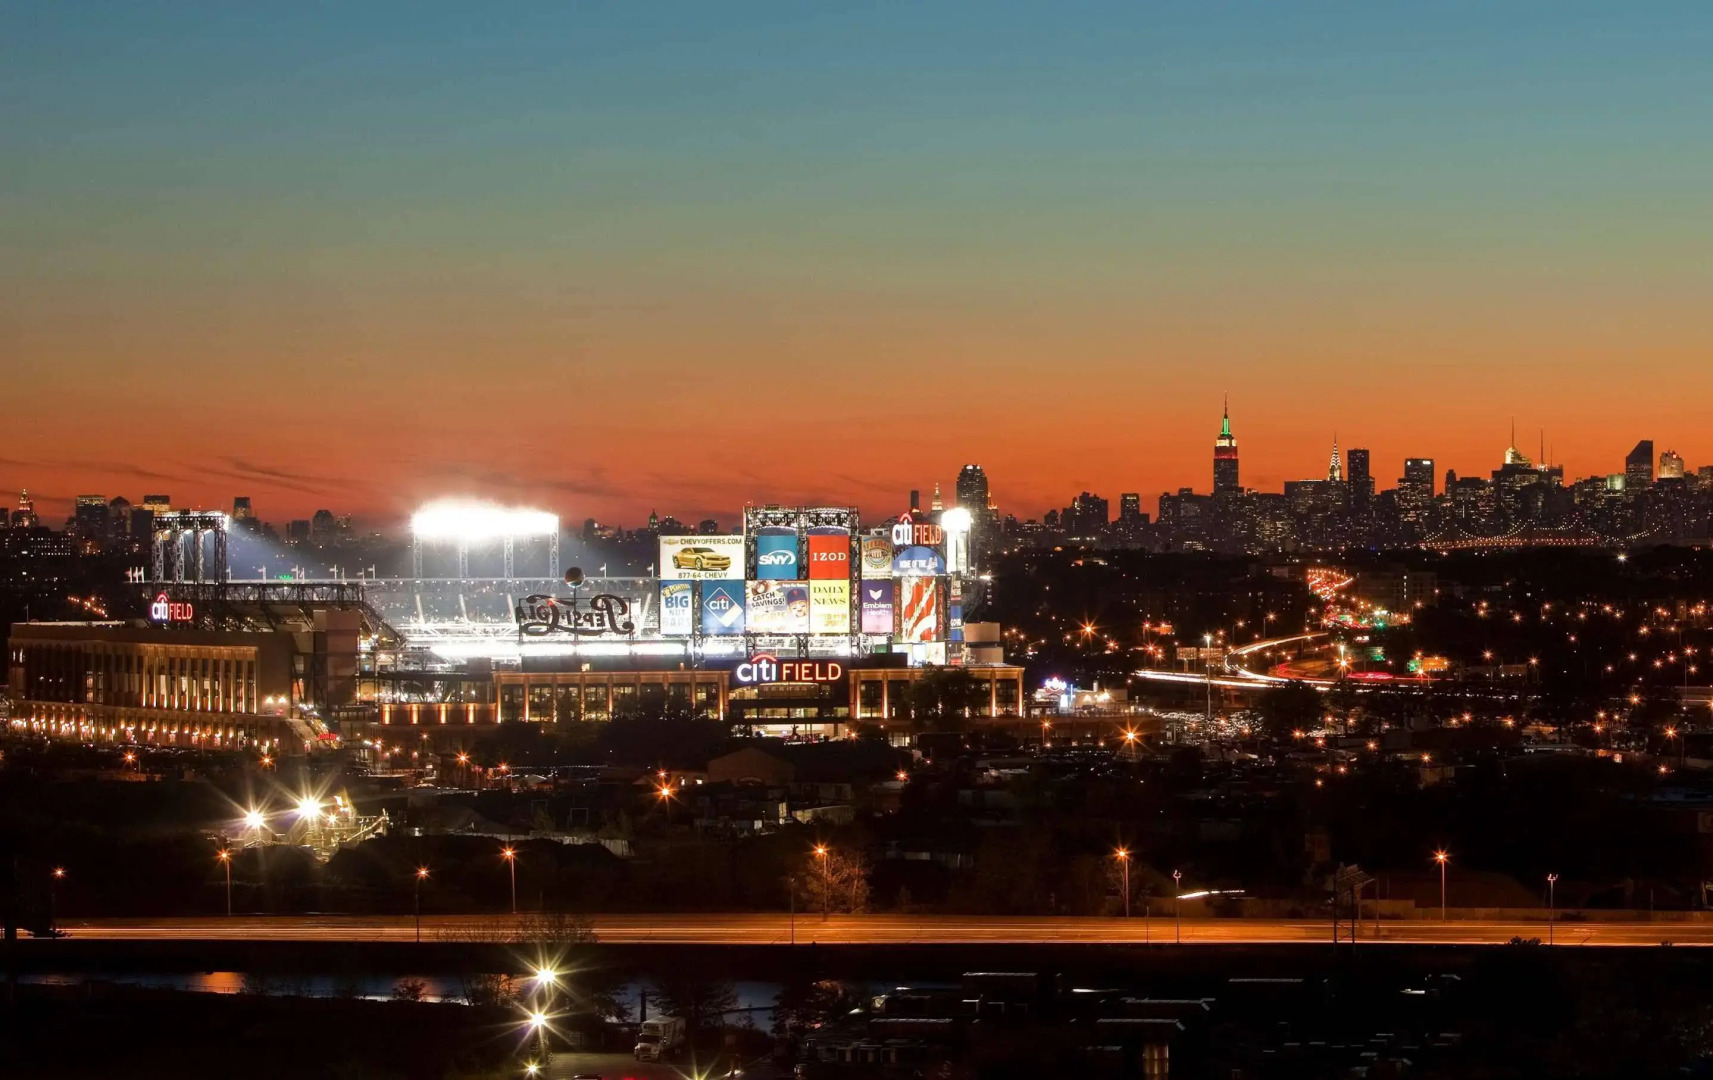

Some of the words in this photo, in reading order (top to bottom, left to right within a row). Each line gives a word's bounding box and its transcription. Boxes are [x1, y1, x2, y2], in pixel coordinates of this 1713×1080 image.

[892, 517, 912, 546] citi
[913, 524, 942, 545] FIELD
[758, 552, 791, 565] SNY
[812, 552, 846, 561] IZOD
[664, 595, 689, 608] BIG
[751, 597, 786, 608] SAVINGS!
[752, 591, 775, 602] CATCH
[709, 597, 729, 610] citi
[169, 603, 193, 620] FIELD
[736, 657, 777, 682] citi
[782, 663, 842, 681] FIELD
